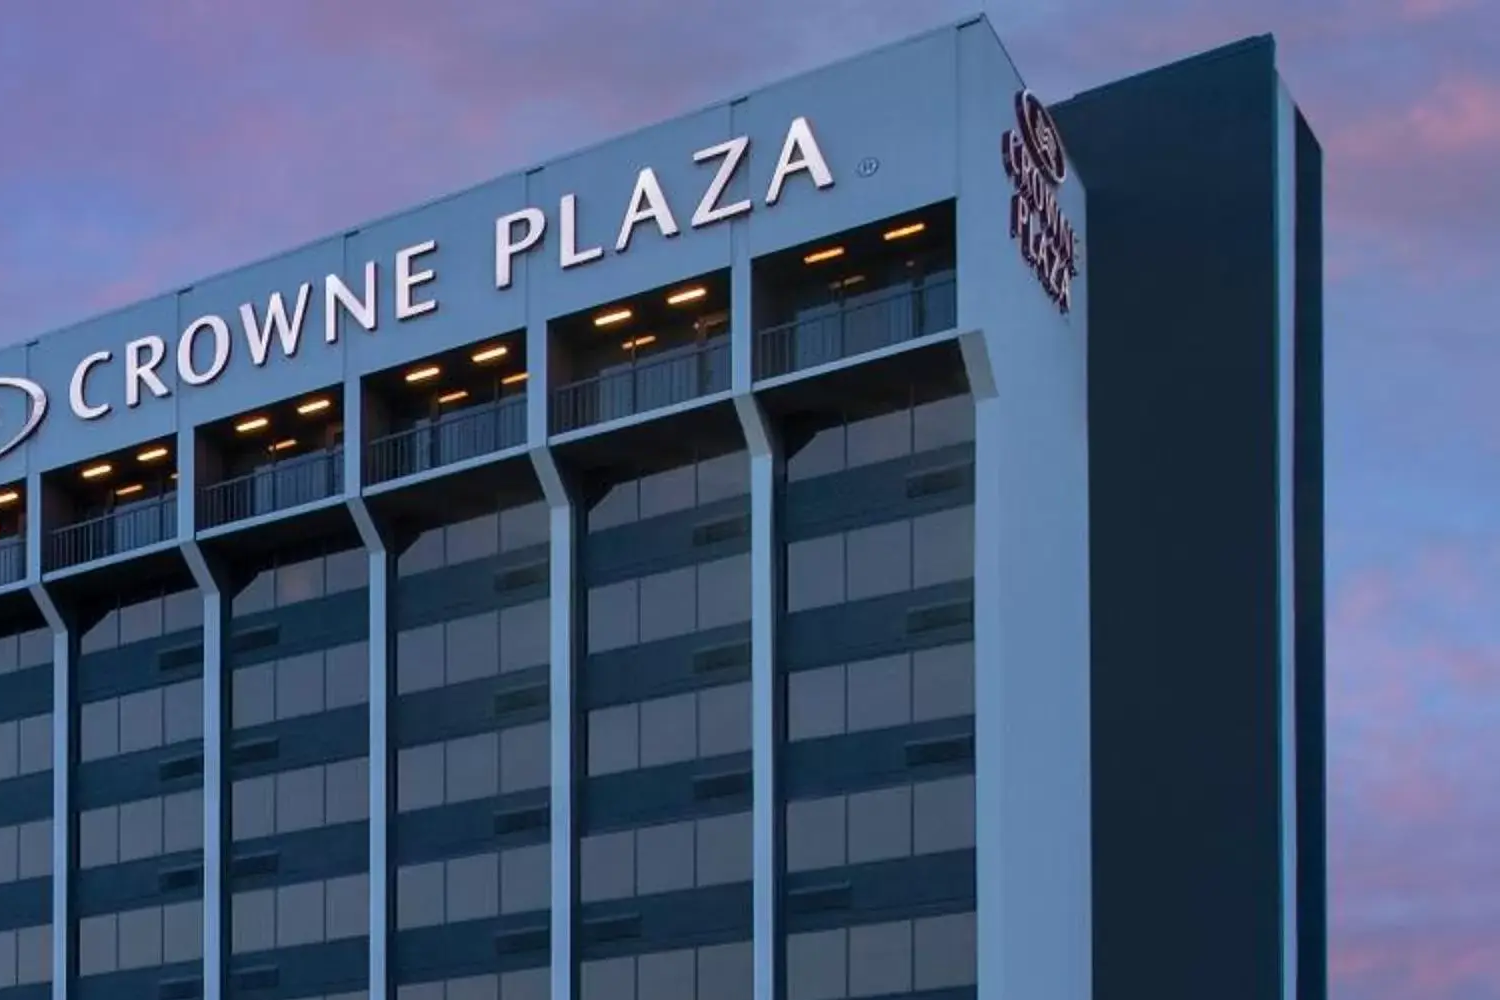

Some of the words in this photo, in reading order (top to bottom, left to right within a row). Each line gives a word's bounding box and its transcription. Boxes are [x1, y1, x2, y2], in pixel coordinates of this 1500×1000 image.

[68, 239, 440, 421] CROWNE
[495, 116, 835, 289] PLAZA
[1011, 195, 1071, 314] PLAZA
